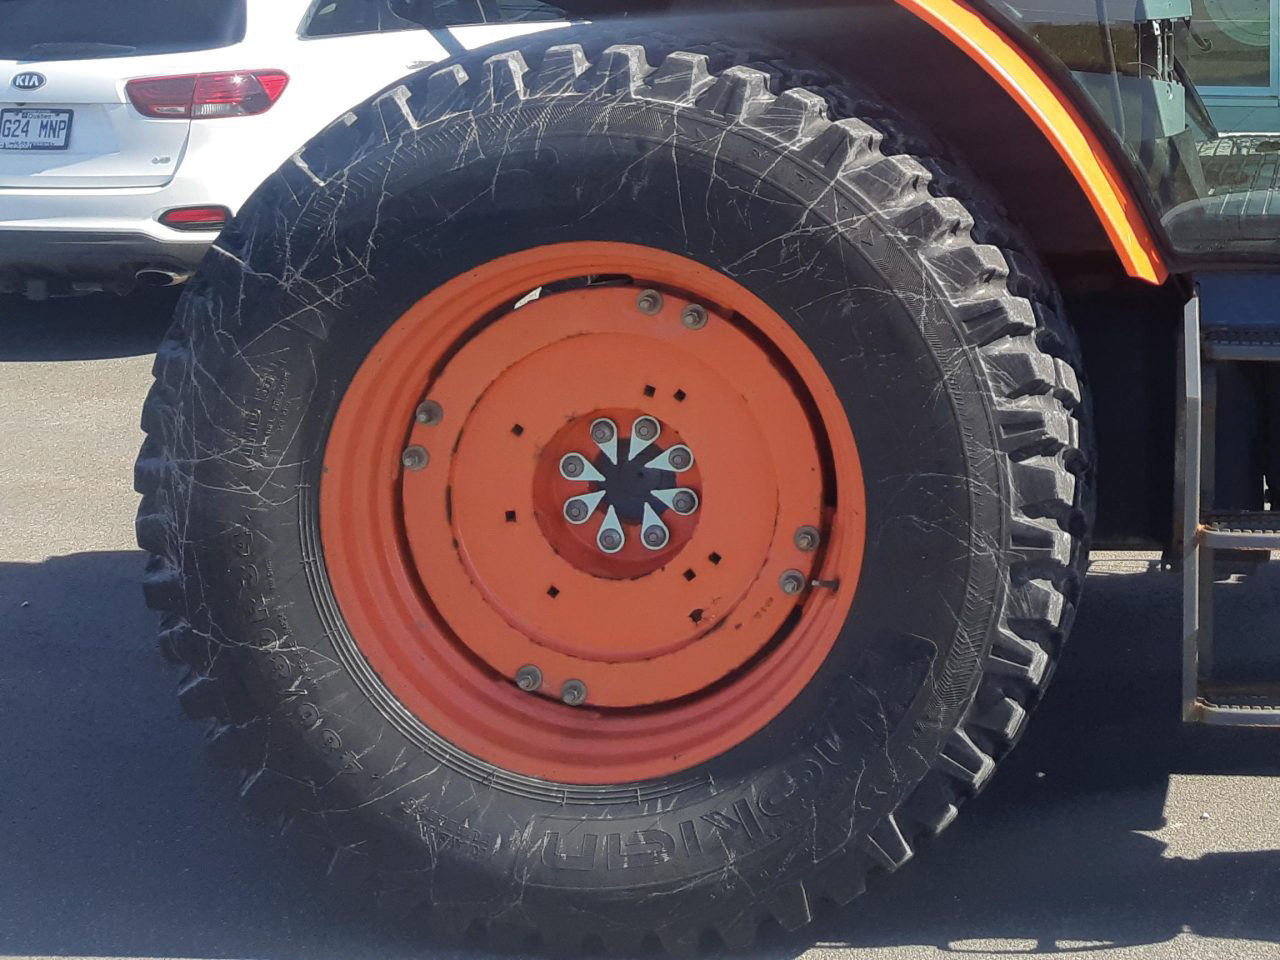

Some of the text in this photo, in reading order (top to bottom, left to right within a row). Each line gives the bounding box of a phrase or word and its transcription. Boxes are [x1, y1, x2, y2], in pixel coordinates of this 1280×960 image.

[16, 75, 39, 86] KIA
[2, 119, 67, 139] G24 MNP
